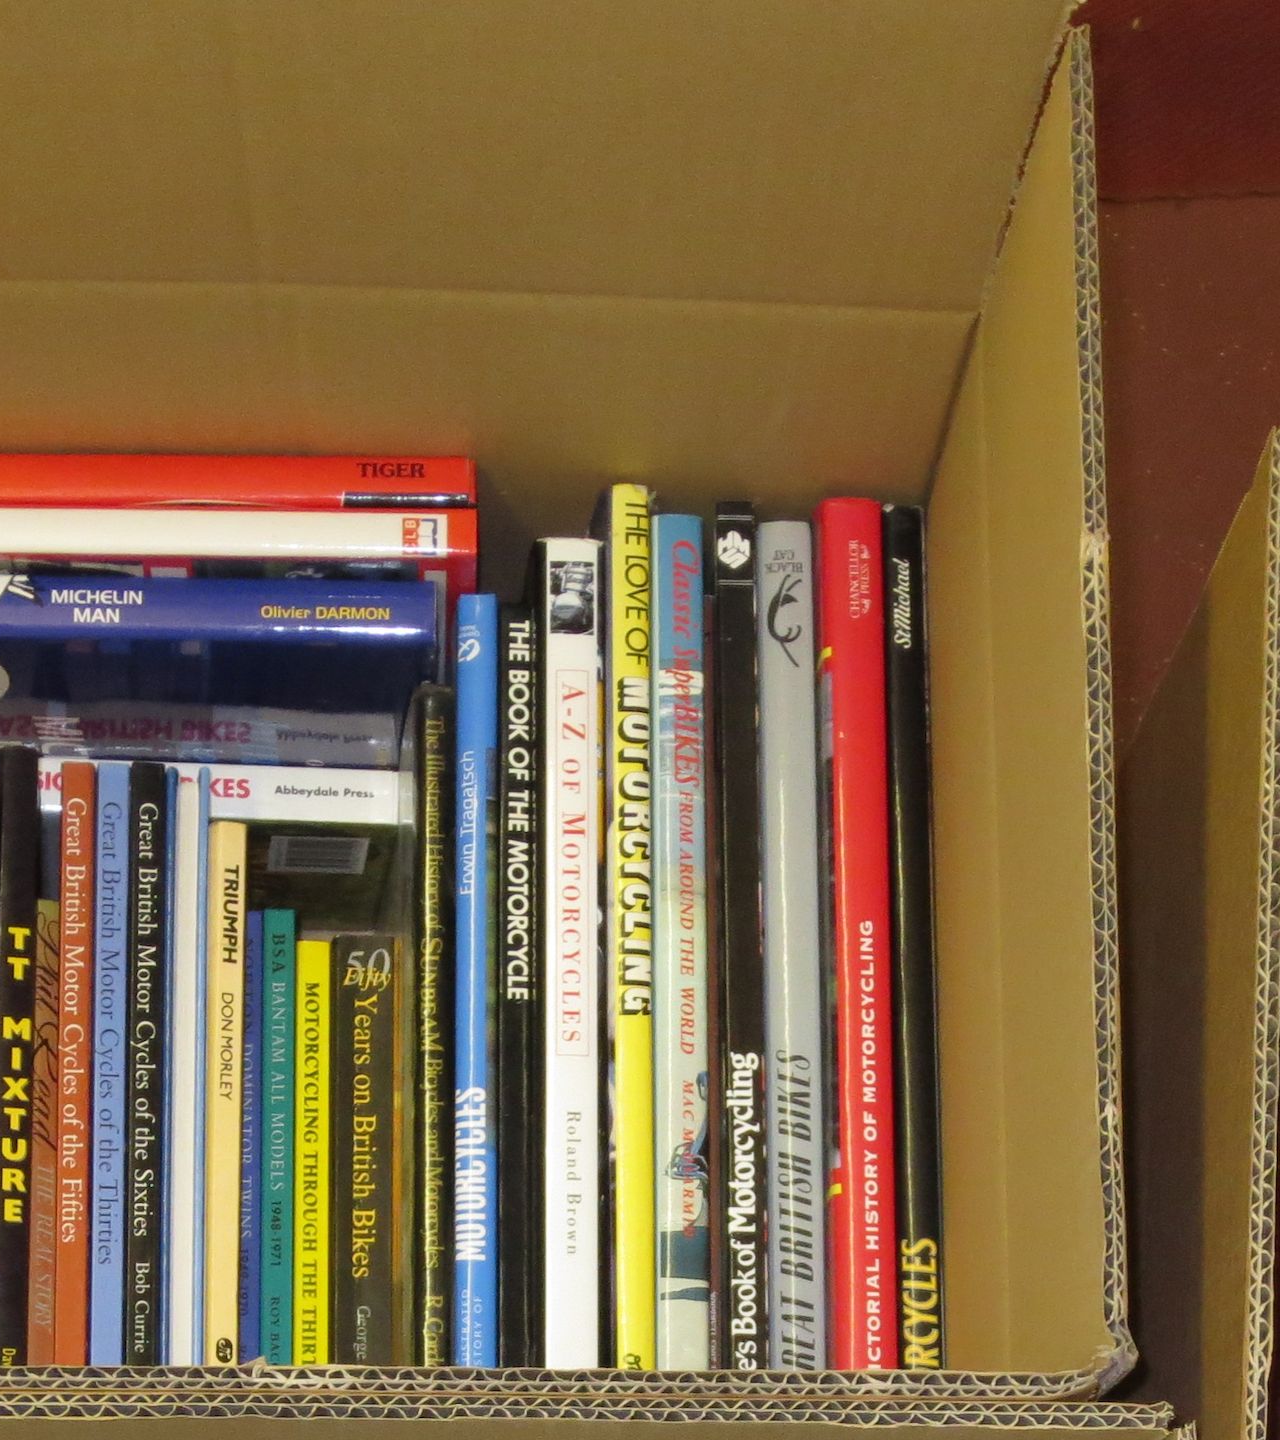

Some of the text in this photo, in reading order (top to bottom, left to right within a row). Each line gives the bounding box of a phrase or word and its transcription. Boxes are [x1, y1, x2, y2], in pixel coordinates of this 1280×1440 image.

[356, 462, 425, 479] TIGER
[51, 589, 143, 606] MICHELIN
[73, 608, 120, 624] MAN
[260, 605, 390, 621] Olivier DARMON
[764, 549, 804, 575] BLACK CAT
[274, 785, 375, 798] Abbeydale Press
[506, 620, 530, 1001] THE BOOK OF THE MOTORCYCLE
[562, 758, 581, 794] OF
[218, 864, 240, 1102] TRIUMPH DON MORLEY
[561, 812, 586, 1044] MOTORCYCLES
[61, 797, 88, 1243] Great British Motor Cycles of the Fifties
[270, 933, 285, 1267] BSA BANTAM ALL MODELS 1948-1971
[302, 981, 320, 1299] MOTORCYCLING THROUGH THE
[566, 1110, 582, 1181] Roland
[860, 919, 881, 1369] ICTORIAL HISTORY OF MOTORCYCLING
[343, 966, 391, 1361] Fifty Years on British Bikes George
[455, 1086, 486, 1261] MOTORCYCLES
[566, 1192, 582, 1255] Brown
